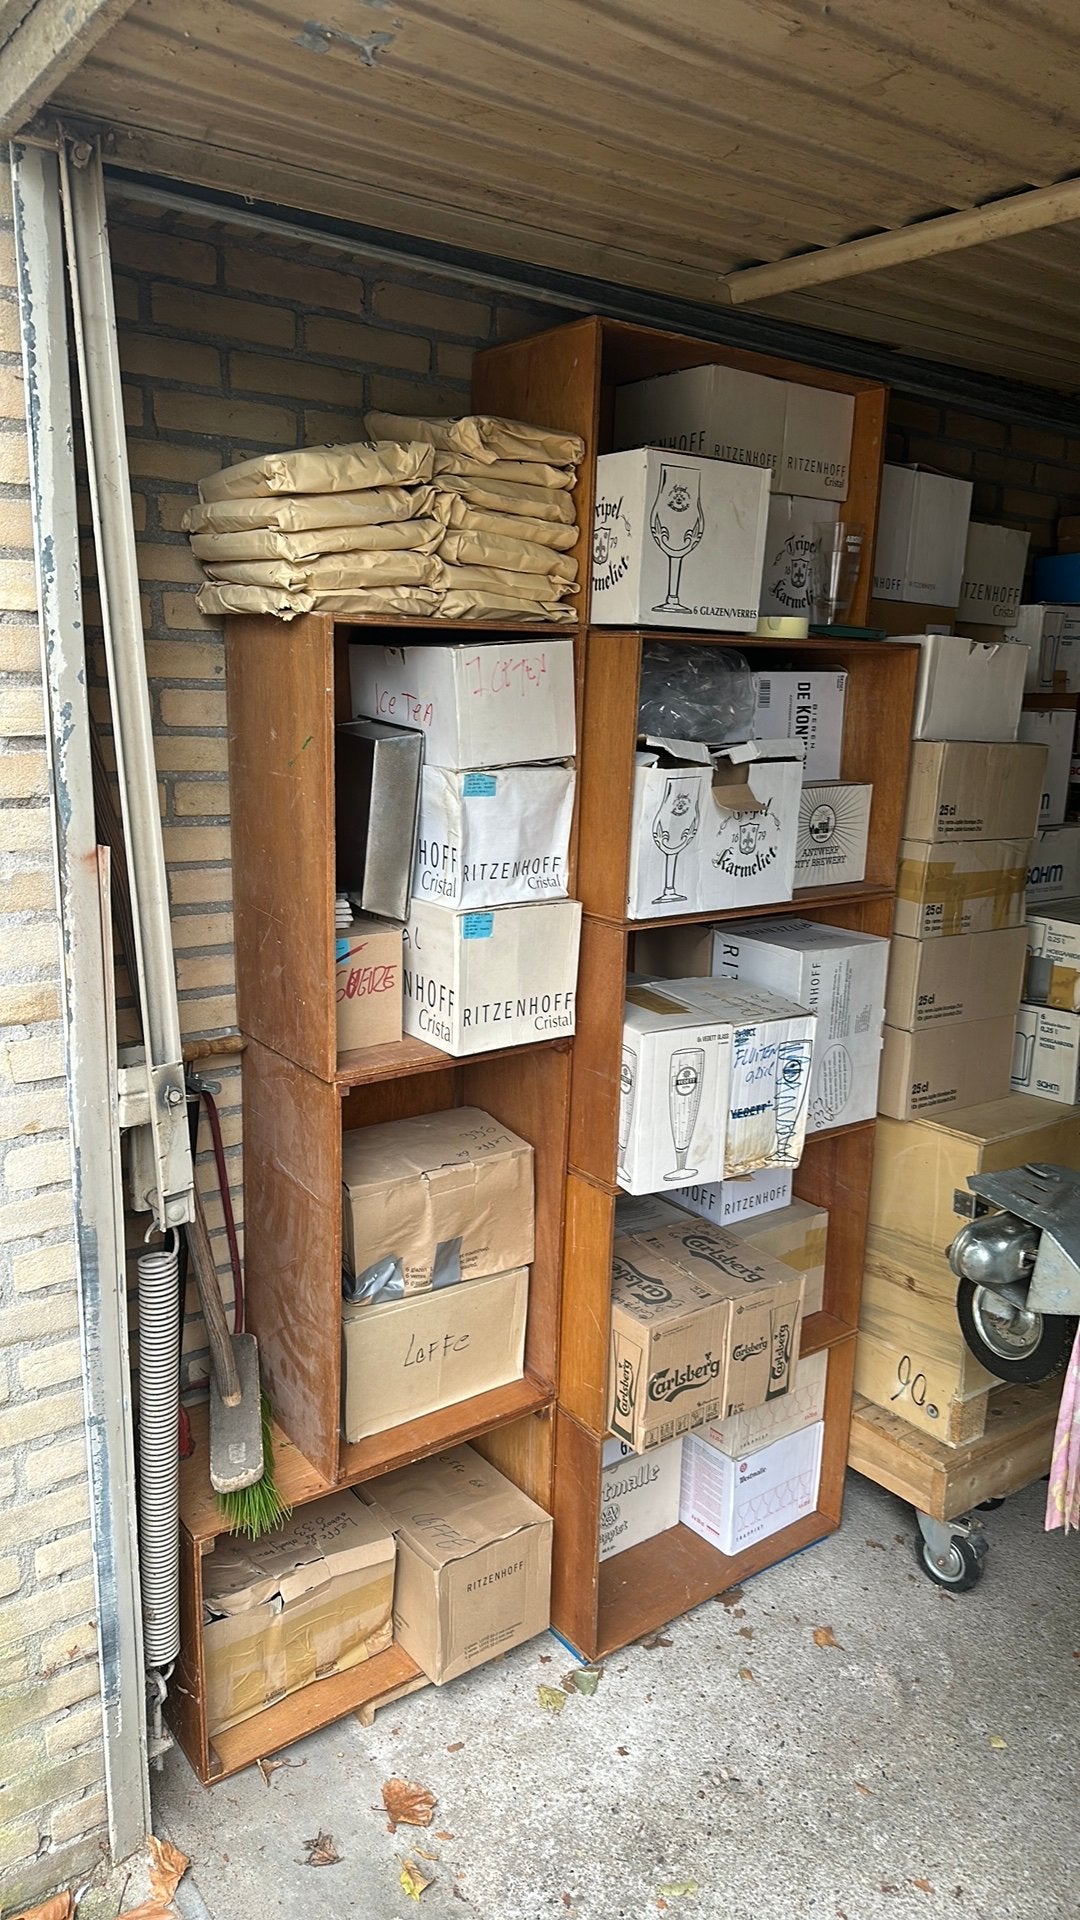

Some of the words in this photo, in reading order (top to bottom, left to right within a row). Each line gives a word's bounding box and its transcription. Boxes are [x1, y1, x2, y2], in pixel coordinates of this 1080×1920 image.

[787, 456, 846, 477] RITZENHOFF
[463, 856, 562, 882] RITZENHOFF
[527, 873, 561, 890] Cristal
[463, 992, 574, 1027] RITZENHOFF
[533, 1012, 574, 1031] Cristal
[724, 1184, 788, 1216] RITZENHOFF
[681, 1235, 766, 1283] Carlsberg
[733, 1337, 768, 1361] Carlsberg
[772, 1324, 790, 1379] Carlsberg
[616, 1358, 634, 1417] Carlsberg
[648, 1352, 721, 1403] Carlsberg
[466, 1560, 524, 1593] RITZENHOFF
